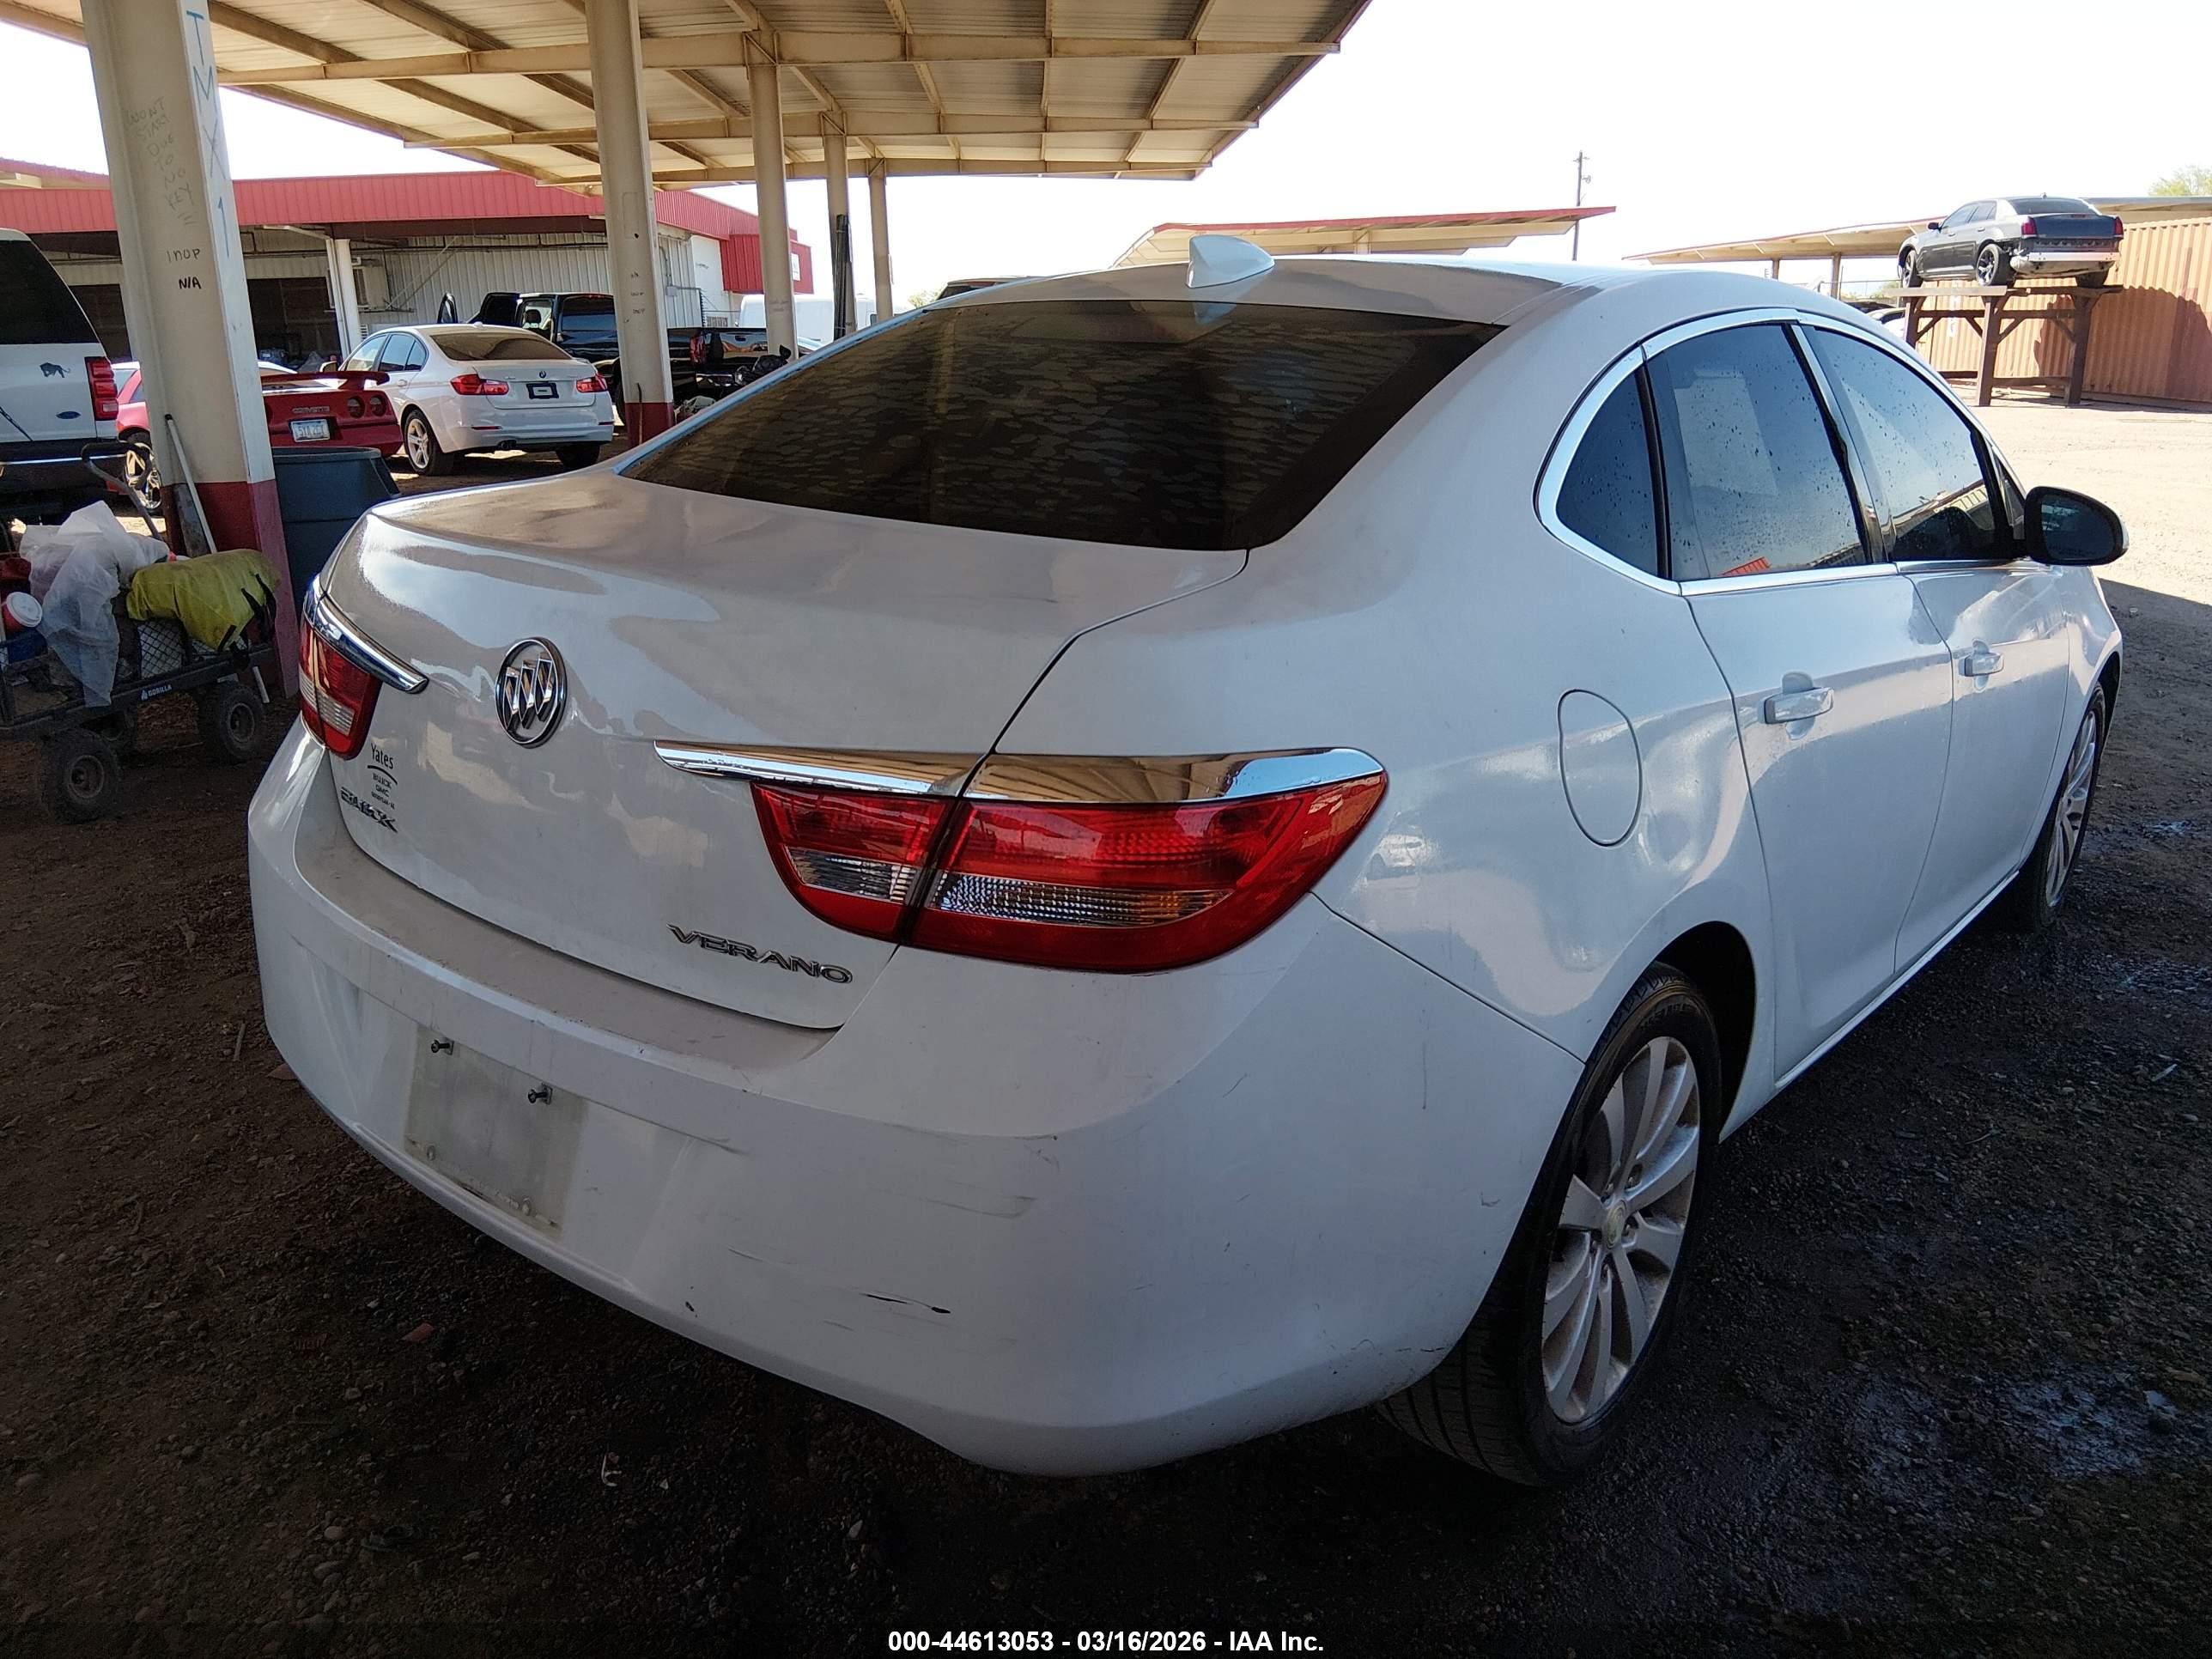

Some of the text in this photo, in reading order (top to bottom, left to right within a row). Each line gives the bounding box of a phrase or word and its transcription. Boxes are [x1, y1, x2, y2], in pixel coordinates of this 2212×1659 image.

[178, 276, 203, 290] N/A
[148, 684, 173, 696] GORILLA
[370, 744, 395, 769] Yates
[666, 922, 854, 984] VERANO
